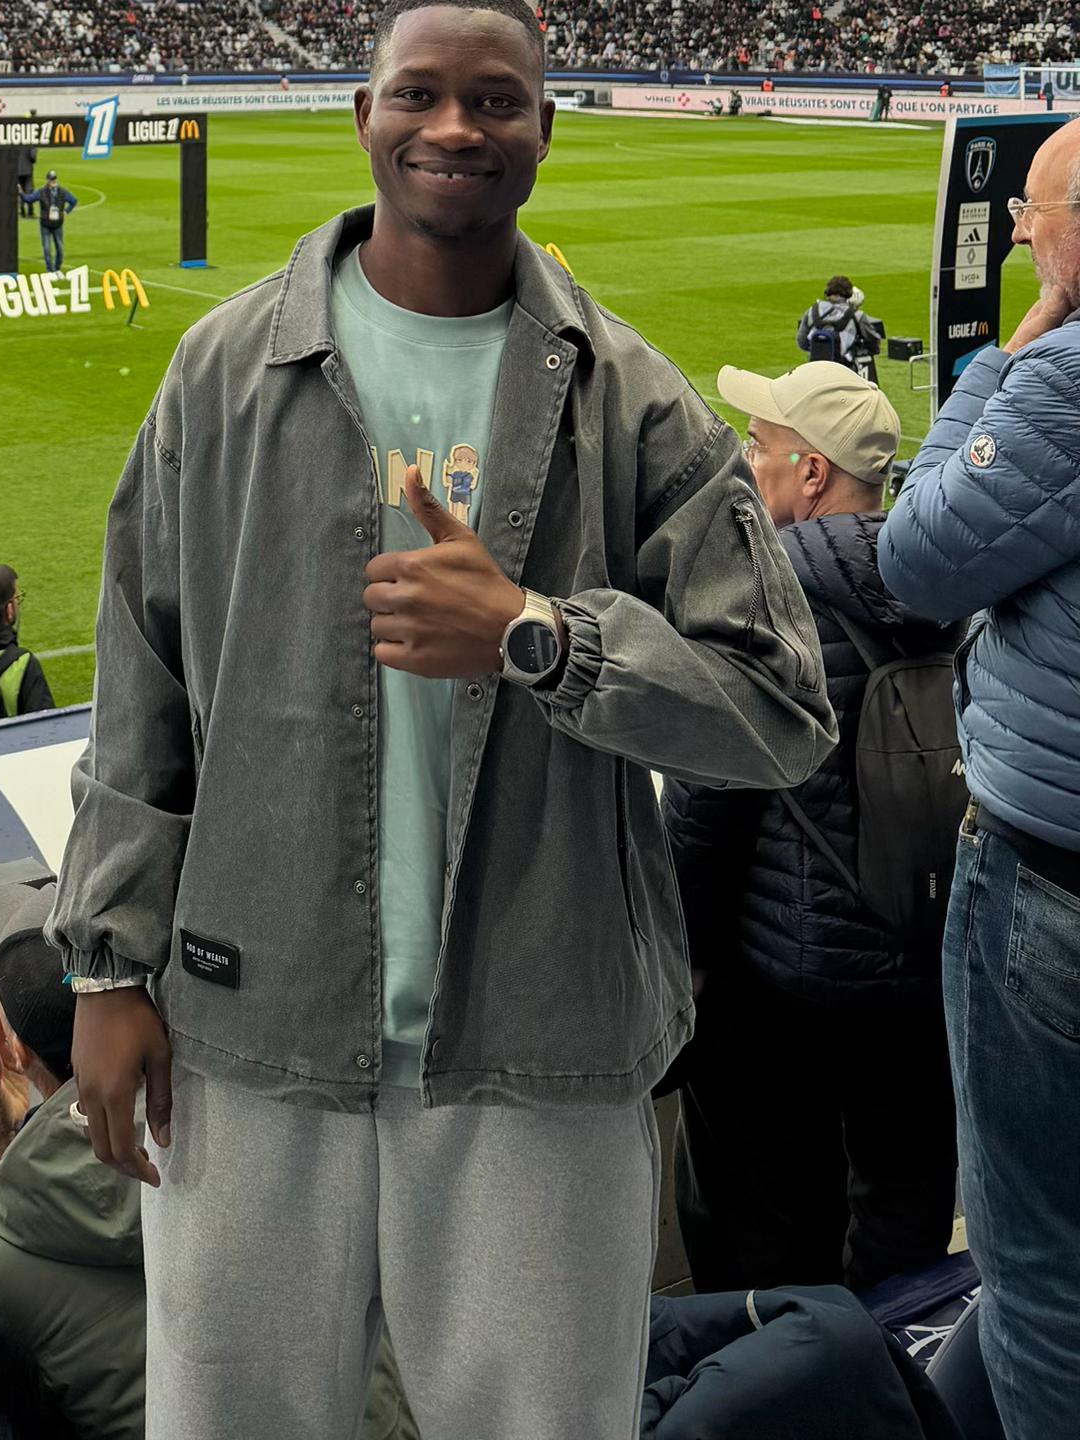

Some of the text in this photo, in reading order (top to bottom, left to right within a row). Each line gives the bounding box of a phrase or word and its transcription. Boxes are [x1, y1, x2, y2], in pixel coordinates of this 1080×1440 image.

[156, 96, 171, 106] LES
[171, 96, 200, 106] VRAIES
[243, 95, 266, 104] SONT
[294, 94, 311, 103] QUE
[644, 95, 676, 103] VINCI
[744, 96, 777, 106] VRAIES
[779, 96, 828, 109] RÉUSSITES
[830, 99, 856, 110] SONT
[895, 102, 1000, 114] QUE L'ON PARTAGE
[205, 951, 229, 966] WEALTH
